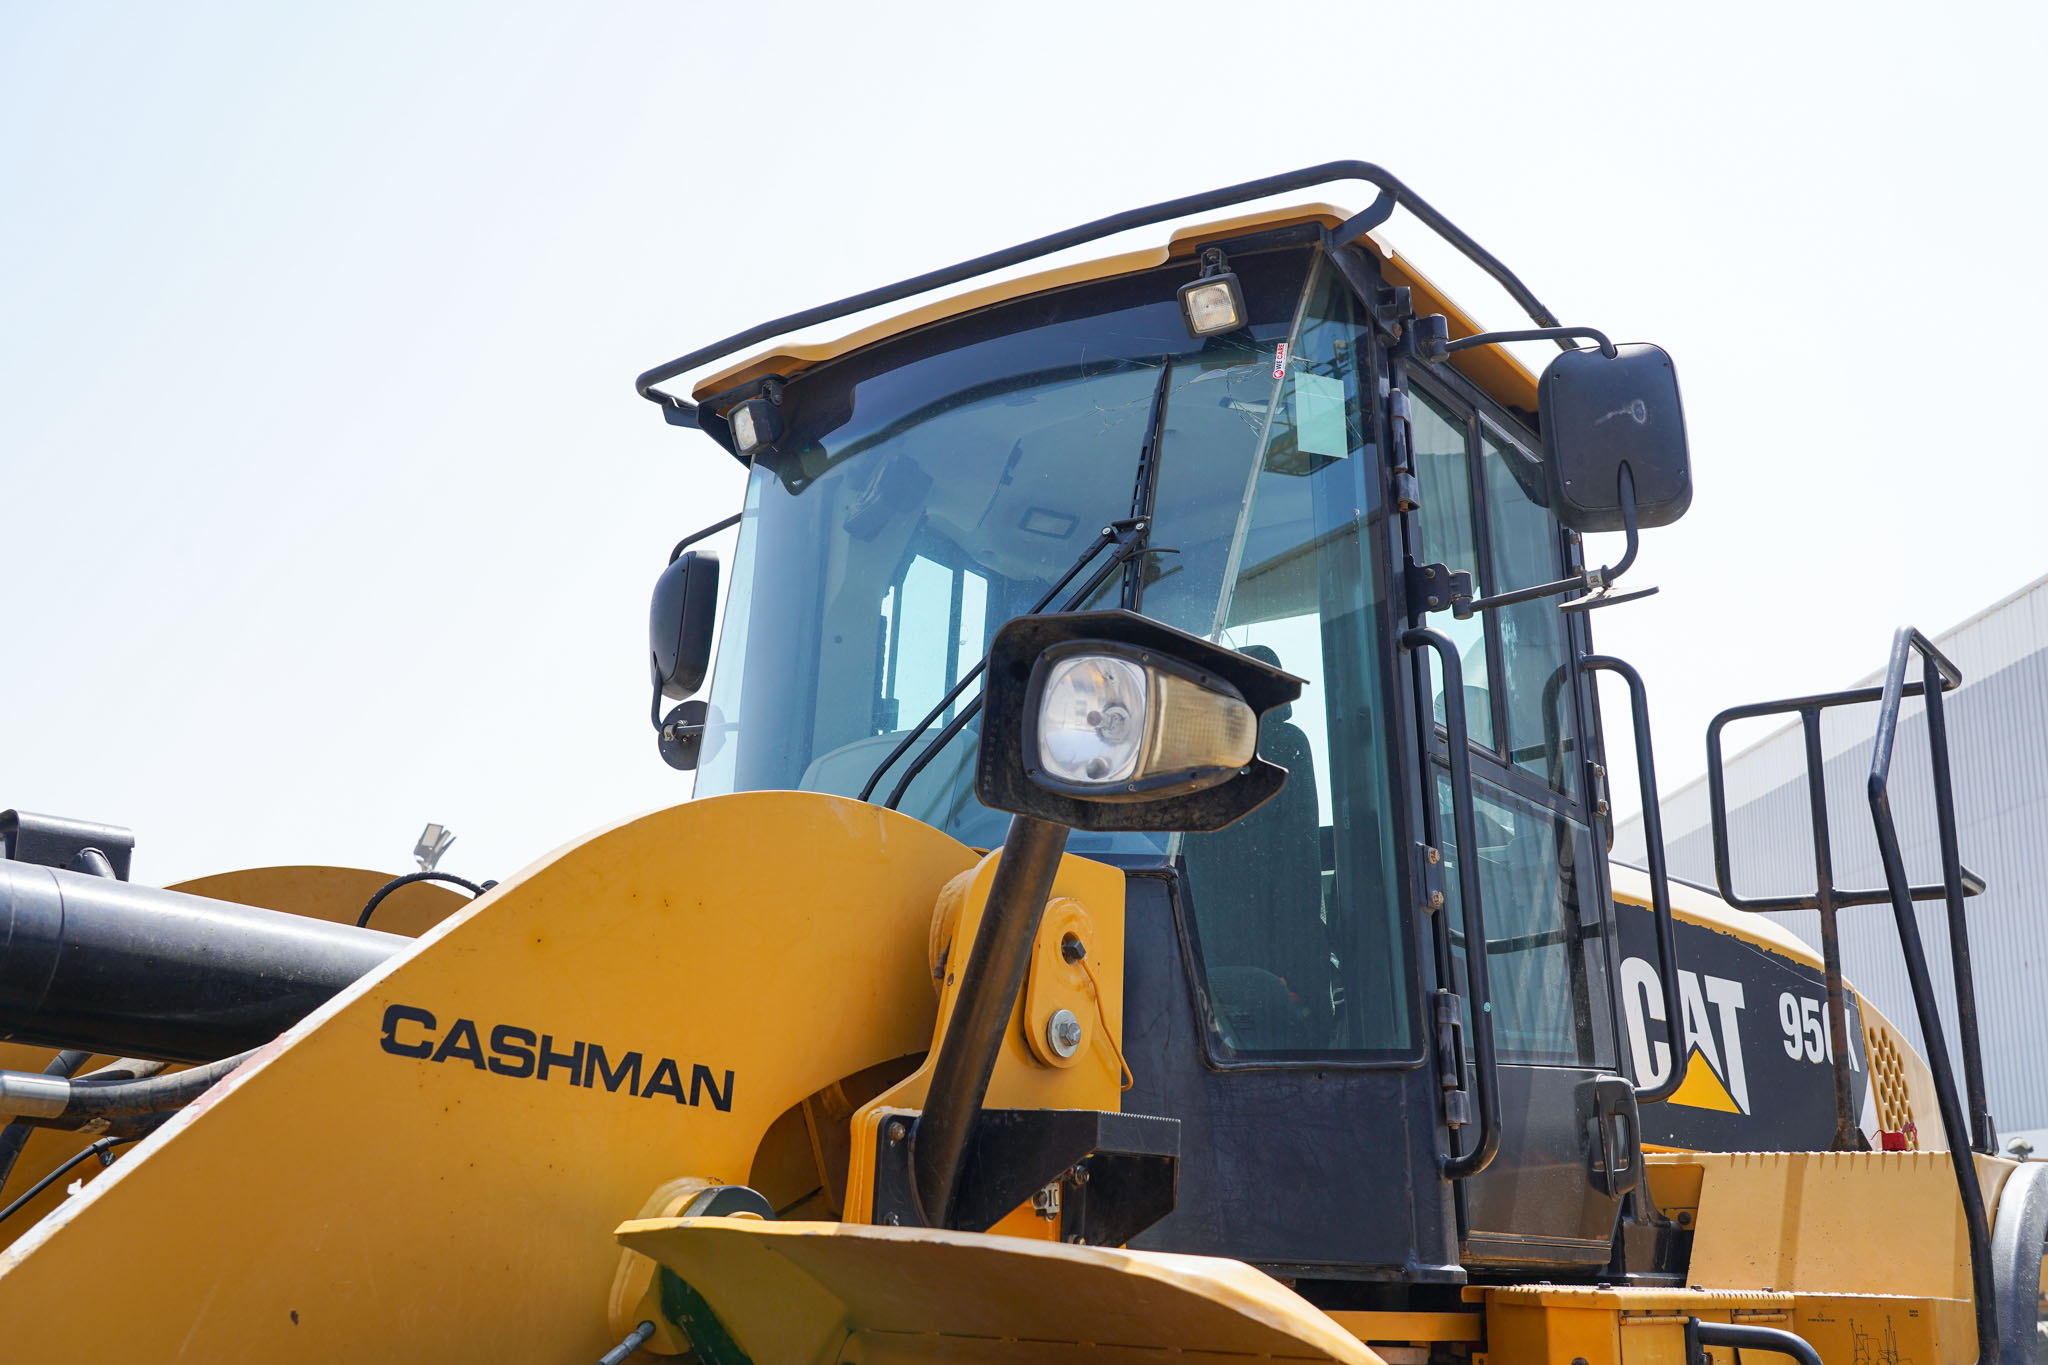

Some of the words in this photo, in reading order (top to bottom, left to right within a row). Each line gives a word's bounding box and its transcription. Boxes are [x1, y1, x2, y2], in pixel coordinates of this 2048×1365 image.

[1275, 360, 1283, 370] WE
[1276, 344, 1285, 360] CARE
[380, 1004, 735, 1113] CASHMAN
[1620, 957, 1751, 1116] CAT
